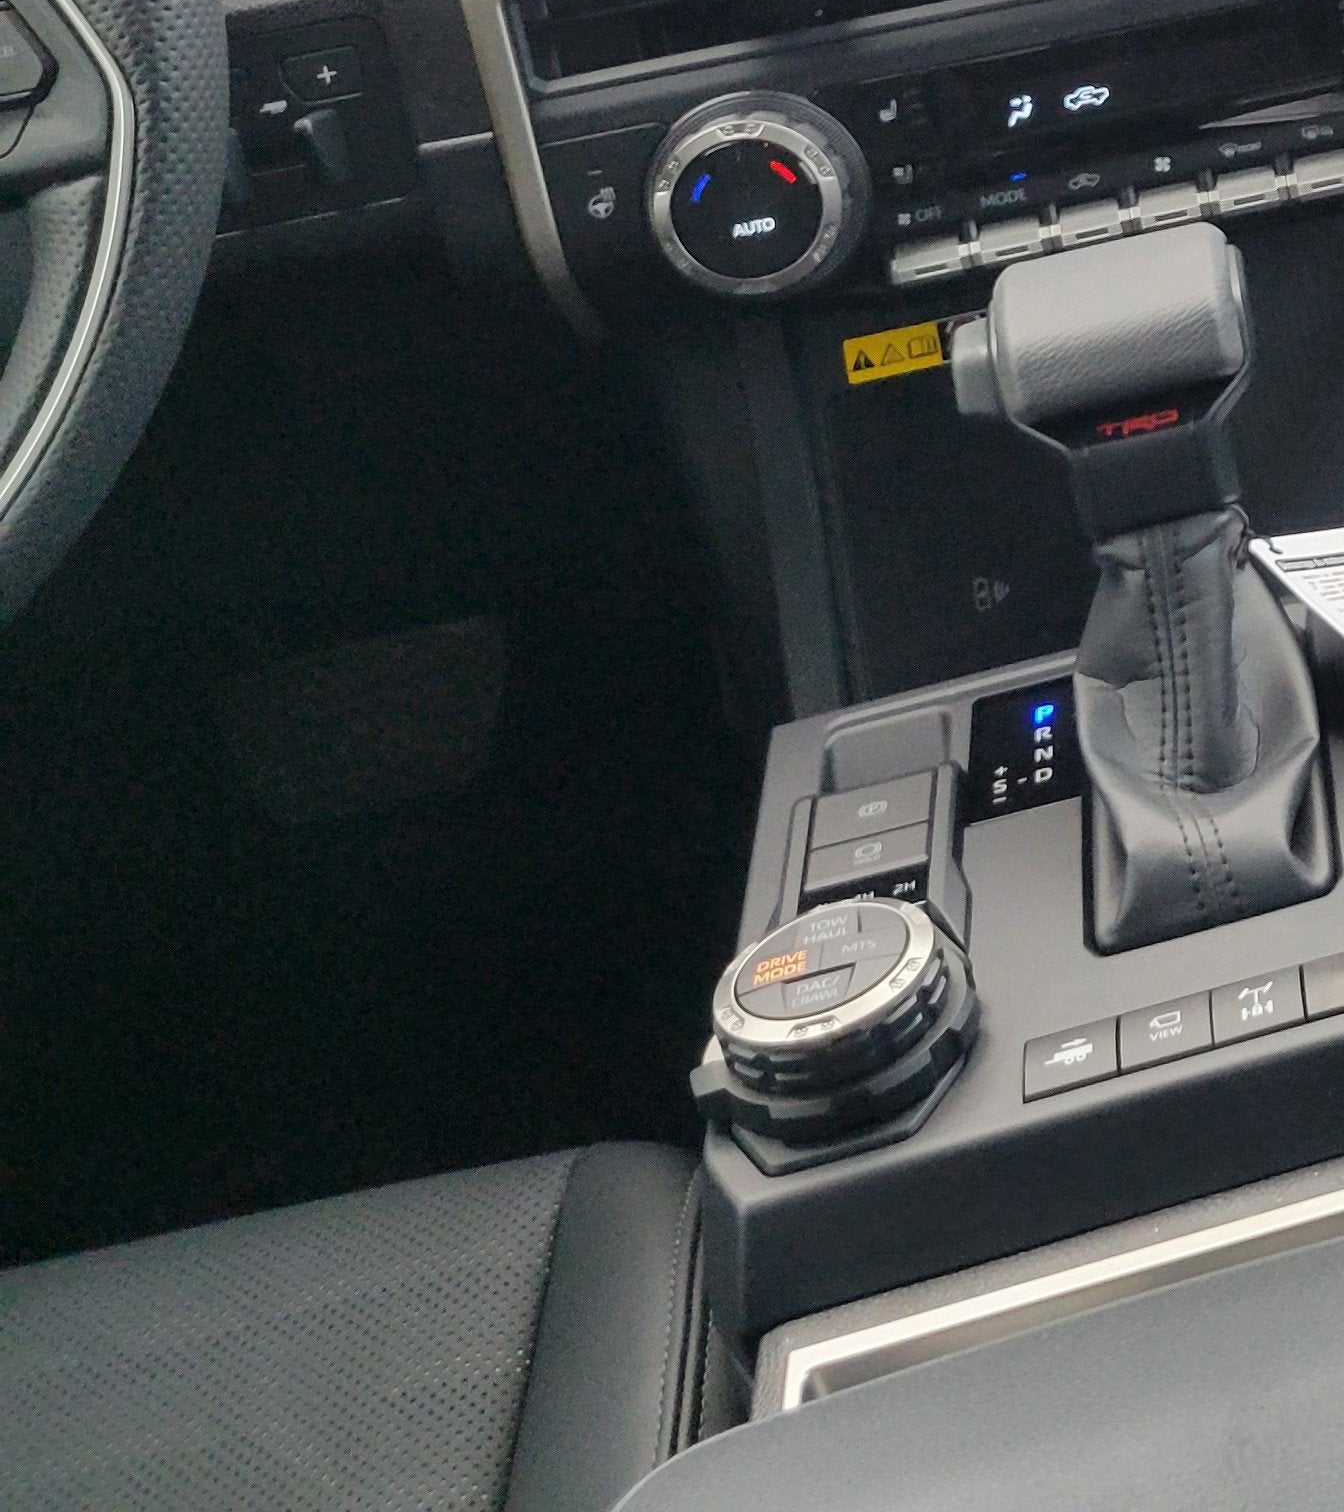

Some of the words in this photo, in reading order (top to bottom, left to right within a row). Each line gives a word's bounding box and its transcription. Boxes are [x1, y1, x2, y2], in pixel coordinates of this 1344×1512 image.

[980, 188, 1028, 208] MODE
[731, 216, 776, 239] AUTO
[1096, 407, 1179, 436] TRD
[1034, 703, 1055, 726] P
[1033, 725, 1053, 743] R
[1033, 745, 1054, 763] N
[1033, 767, 1053, 784] D
[756, 948, 808, 973] DRIVE
[753, 960, 807, 987] MODE
[1149, 1024, 1183, 1043] VIEW
